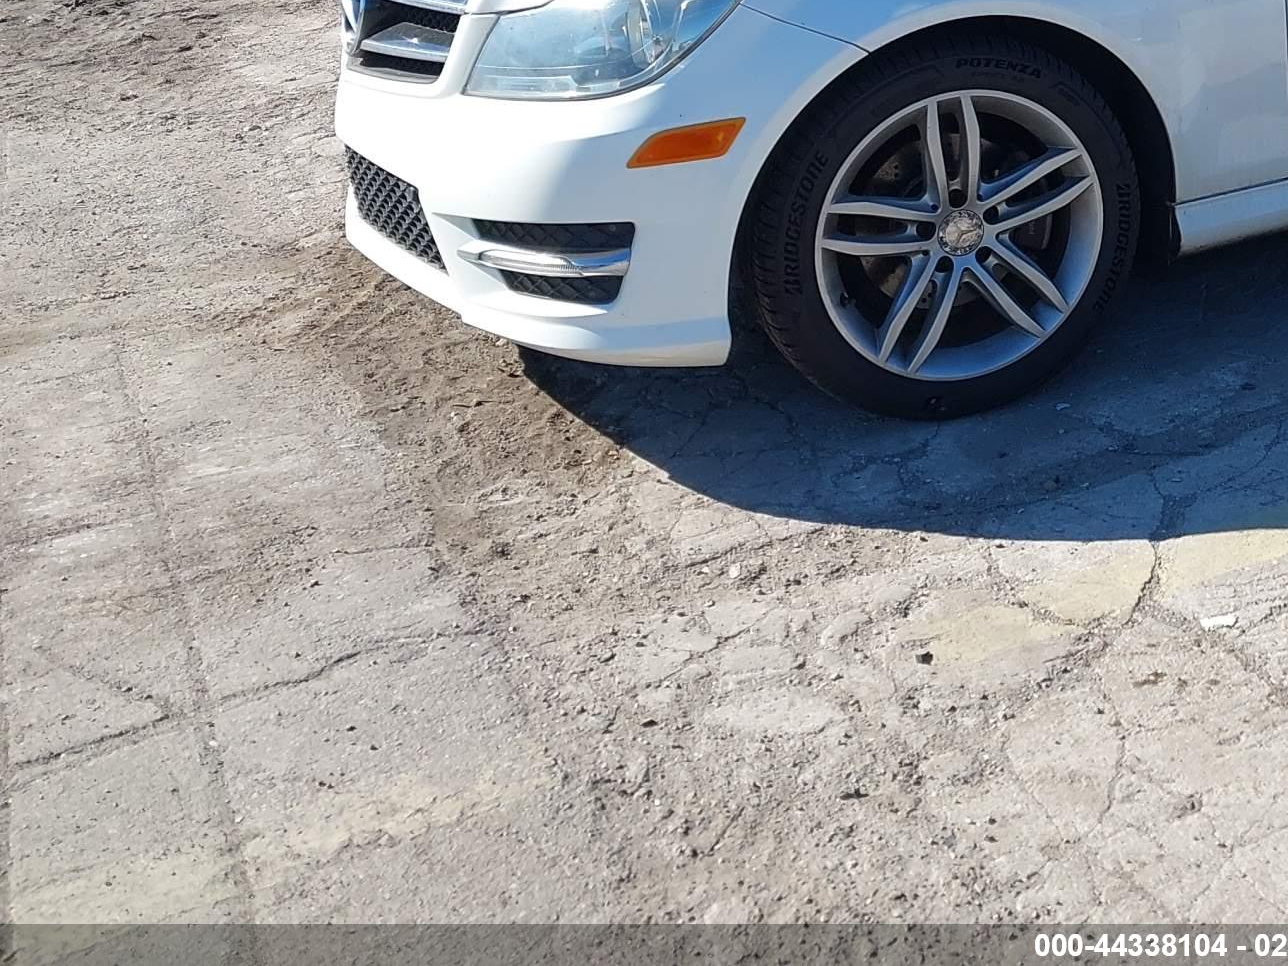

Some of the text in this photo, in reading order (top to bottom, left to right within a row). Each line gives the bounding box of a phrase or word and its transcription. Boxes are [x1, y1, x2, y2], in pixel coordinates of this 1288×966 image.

[954, 57, 1041, 79] POTENZA
[783, 149, 829, 296] BRIDGESTONE
[1092, 182, 1133, 315] BRIDGESTONE
